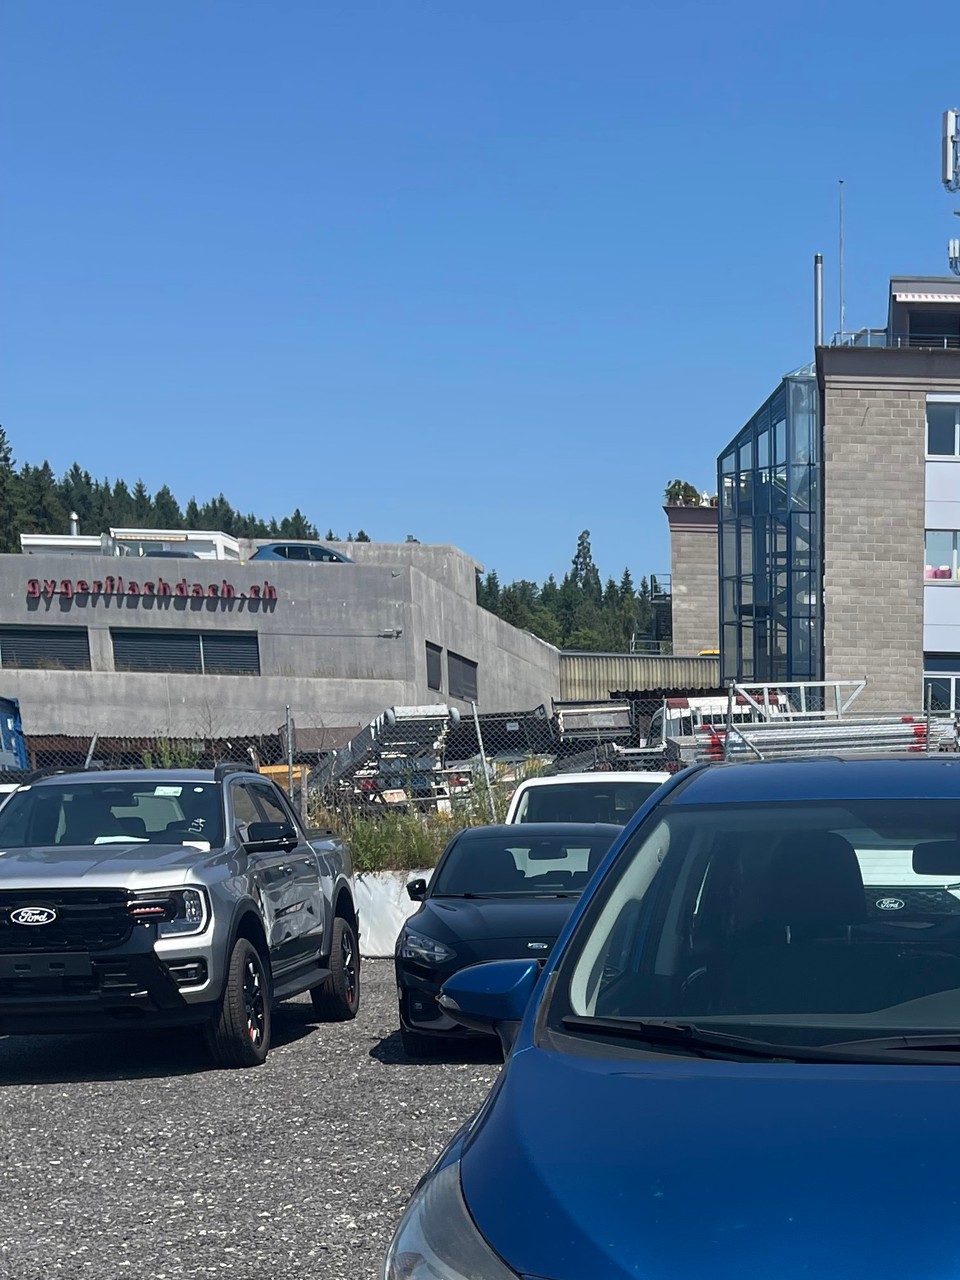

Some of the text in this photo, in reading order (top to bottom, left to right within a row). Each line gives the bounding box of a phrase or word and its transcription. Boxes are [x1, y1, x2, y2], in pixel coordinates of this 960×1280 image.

[27, 575, 277, 600] gygerflachdach.ch
[880, 899, 899, 908] Ford
[18, 909, 48, 922] Ford
